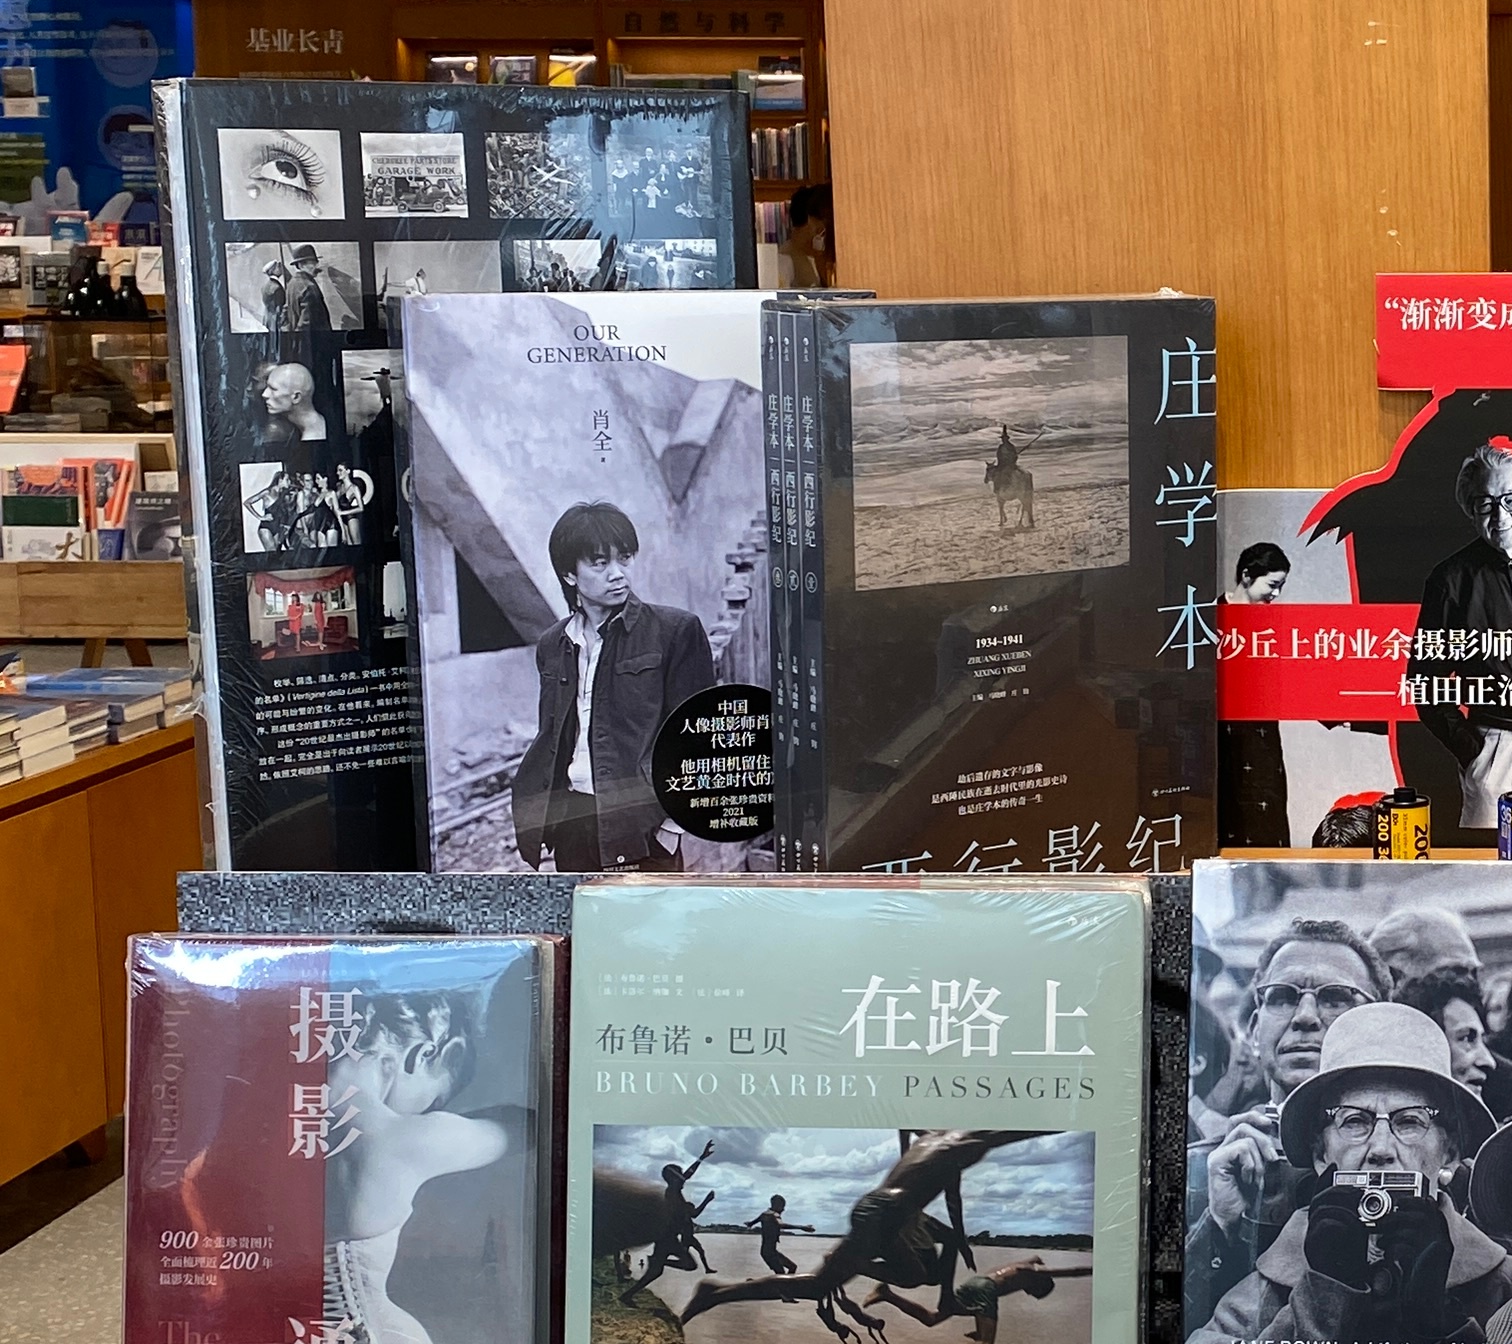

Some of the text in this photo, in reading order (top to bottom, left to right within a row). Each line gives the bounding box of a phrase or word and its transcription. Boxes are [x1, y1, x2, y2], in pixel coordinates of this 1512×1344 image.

[246, 27, 344, 54] 基业长青
[377, 166, 456, 176] GARAGE WORK
[574, 325, 621, 343] OUR
[527, 344, 668, 365] GENERATION
[592, 408, 613, 453] 肖全
[804, 471, 817, 548] 西行影纪
[1154, 336, 1217, 671] 庄学本
[717, 699, 749, 716] 中国
[680, 714, 773, 735] 人像摄影师肖
[711, 731, 757, 749] 代表作
[680, 754, 772, 775] 他用相机留住
[665, 771, 775, 793] 文艺黄金时代的
[709, 815, 759, 829] 增补收藏版
[722, 807, 745, 817] 2021
[1377, 813, 1391, 843] 200
[839, 974, 1097, 1058] 在路上
[596, 1023, 789, 1057] 布鲁诺·巴贝
[289, 987, 364, 1160] 摄影
[596, 1072, 1097, 1100] BRUNO BARBEY PASSAGES
[159, 1229, 276, 1251] 900 余张珍贵图片
[219, 1251, 260, 1273] 200
[159, 1272, 218, 1287] 摄影发展史
